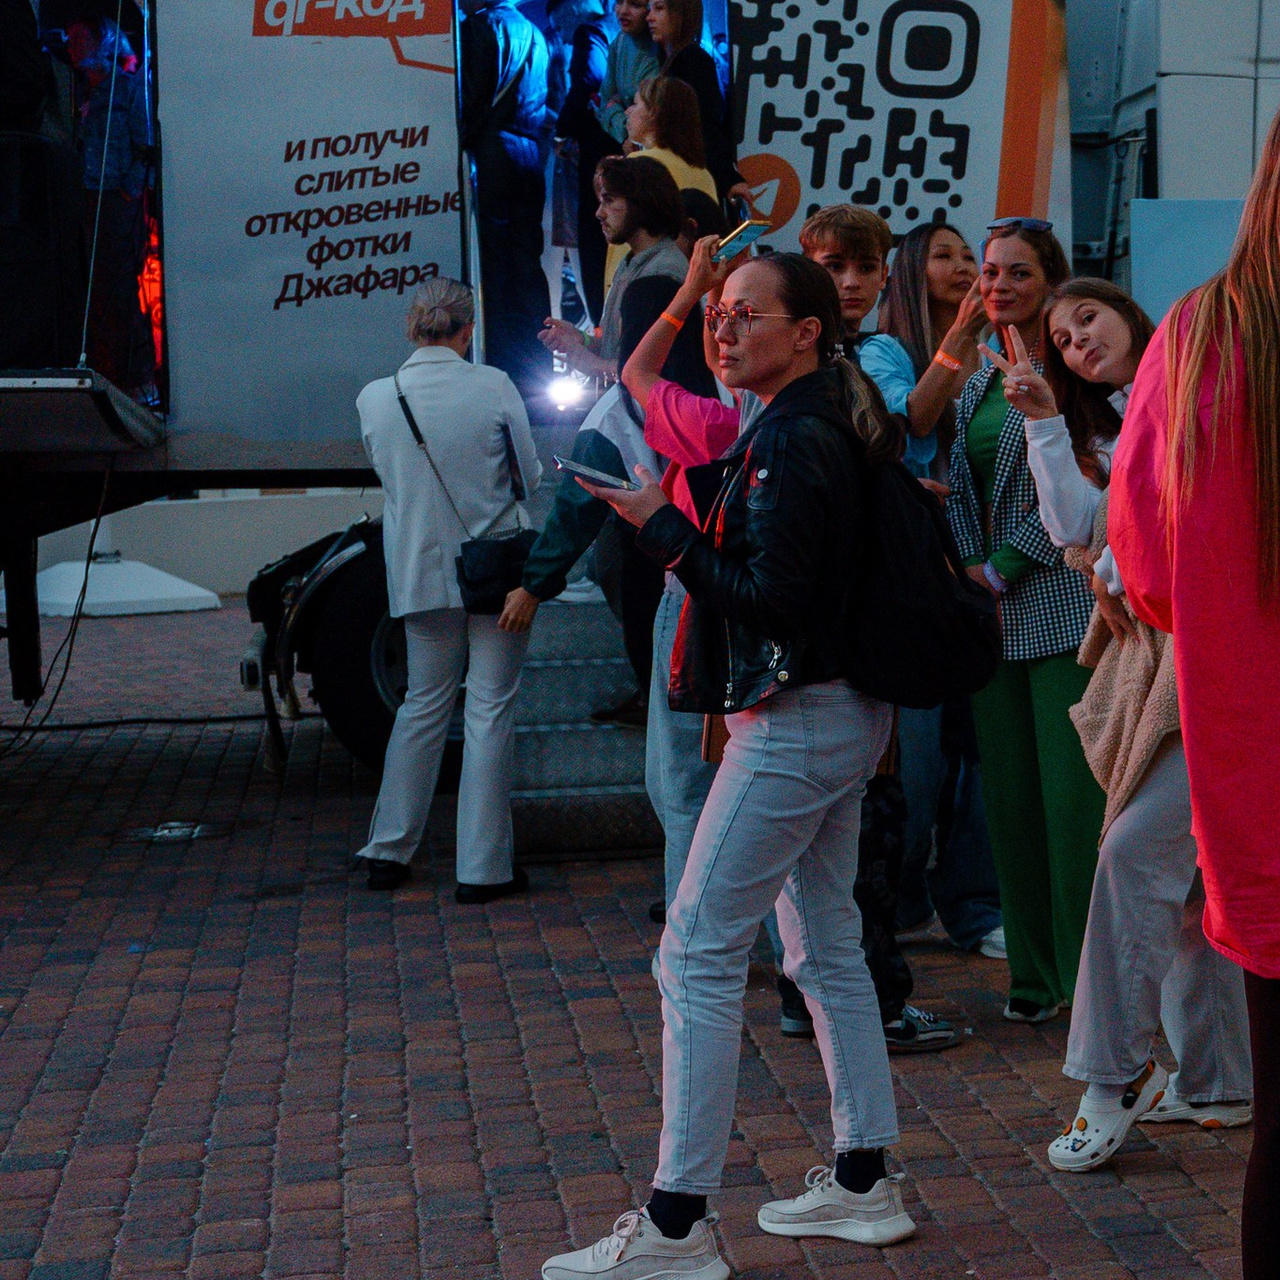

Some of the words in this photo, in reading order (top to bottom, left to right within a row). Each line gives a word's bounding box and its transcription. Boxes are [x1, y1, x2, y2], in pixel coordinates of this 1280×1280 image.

[283, 140, 306, 163] и
[310, 125, 430, 161] получи
[294, 161, 421, 196] слитые
[244, 190, 463, 238] откровенные
[306, 231, 412, 271] фотки
[273, 262, 439, 310] Джафара
